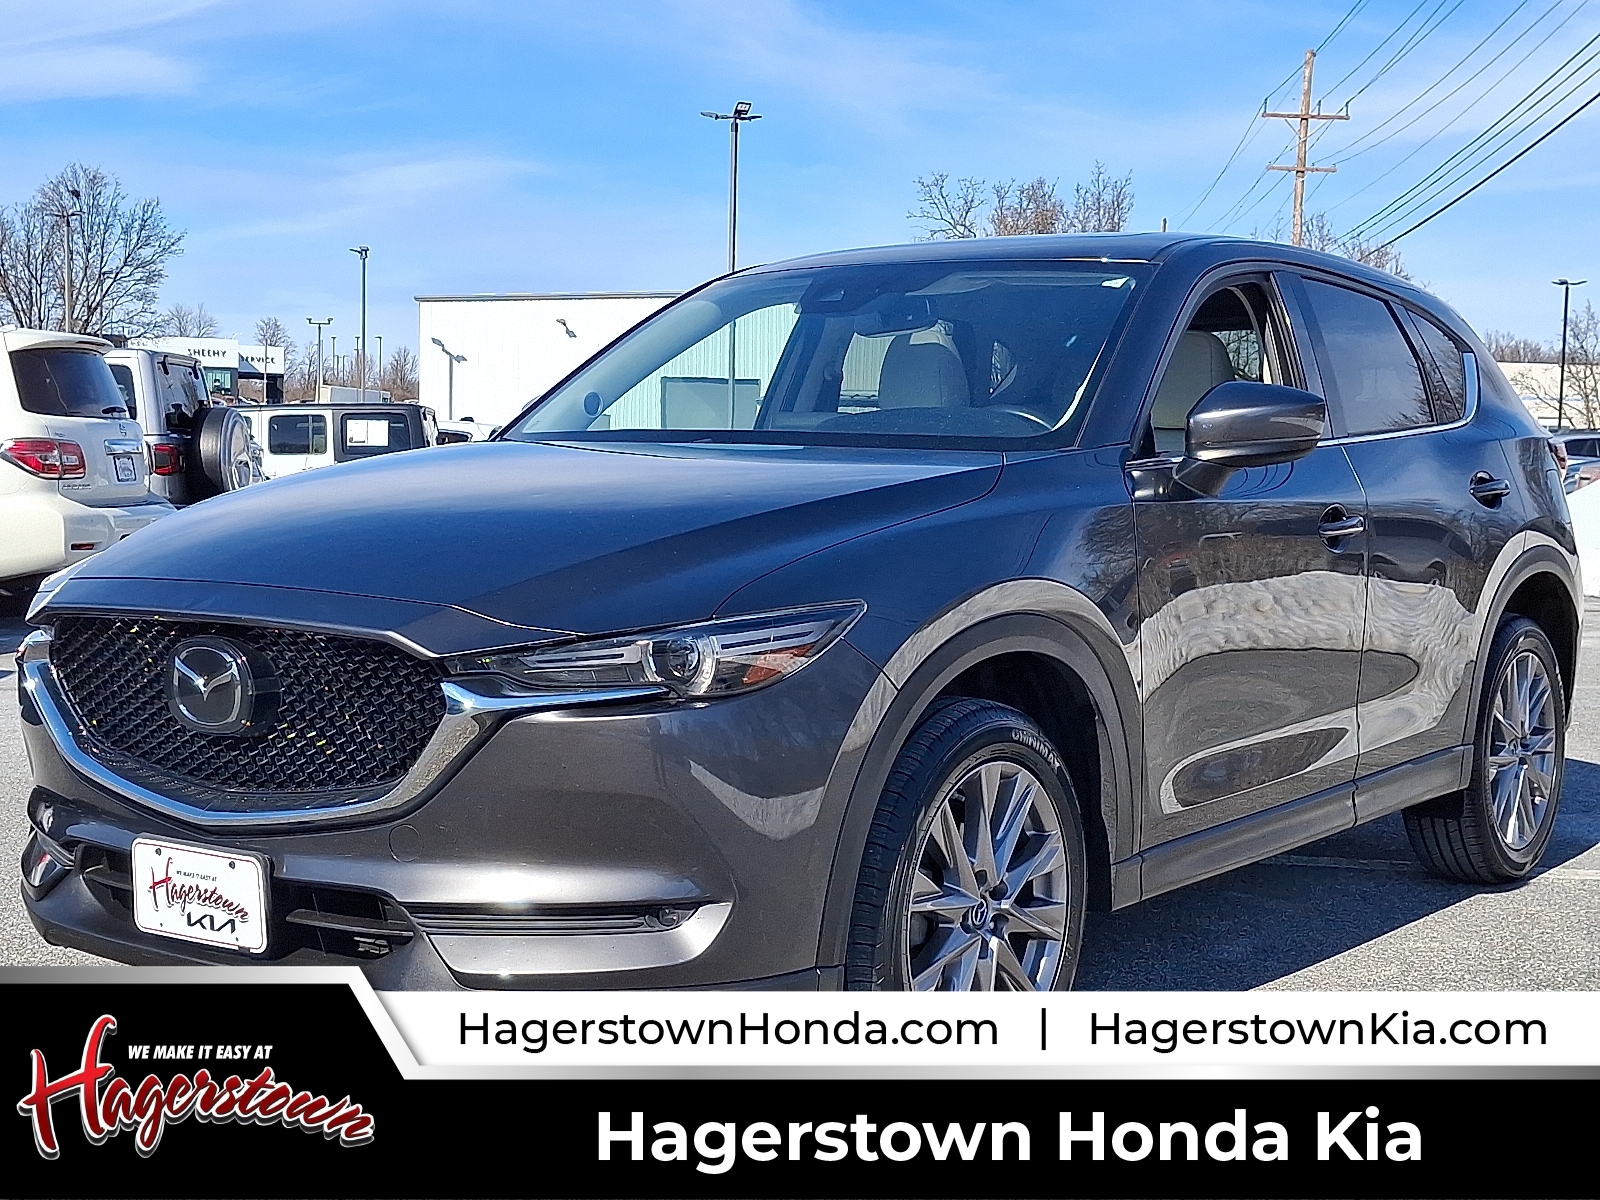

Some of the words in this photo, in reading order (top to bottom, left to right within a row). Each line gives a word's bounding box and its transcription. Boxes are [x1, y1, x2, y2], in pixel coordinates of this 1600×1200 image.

[187, 348, 227, 358] SHEEHY
[240, 355, 276, 365] SERVICE
[148, 857, 249, 922] Hagerstown
